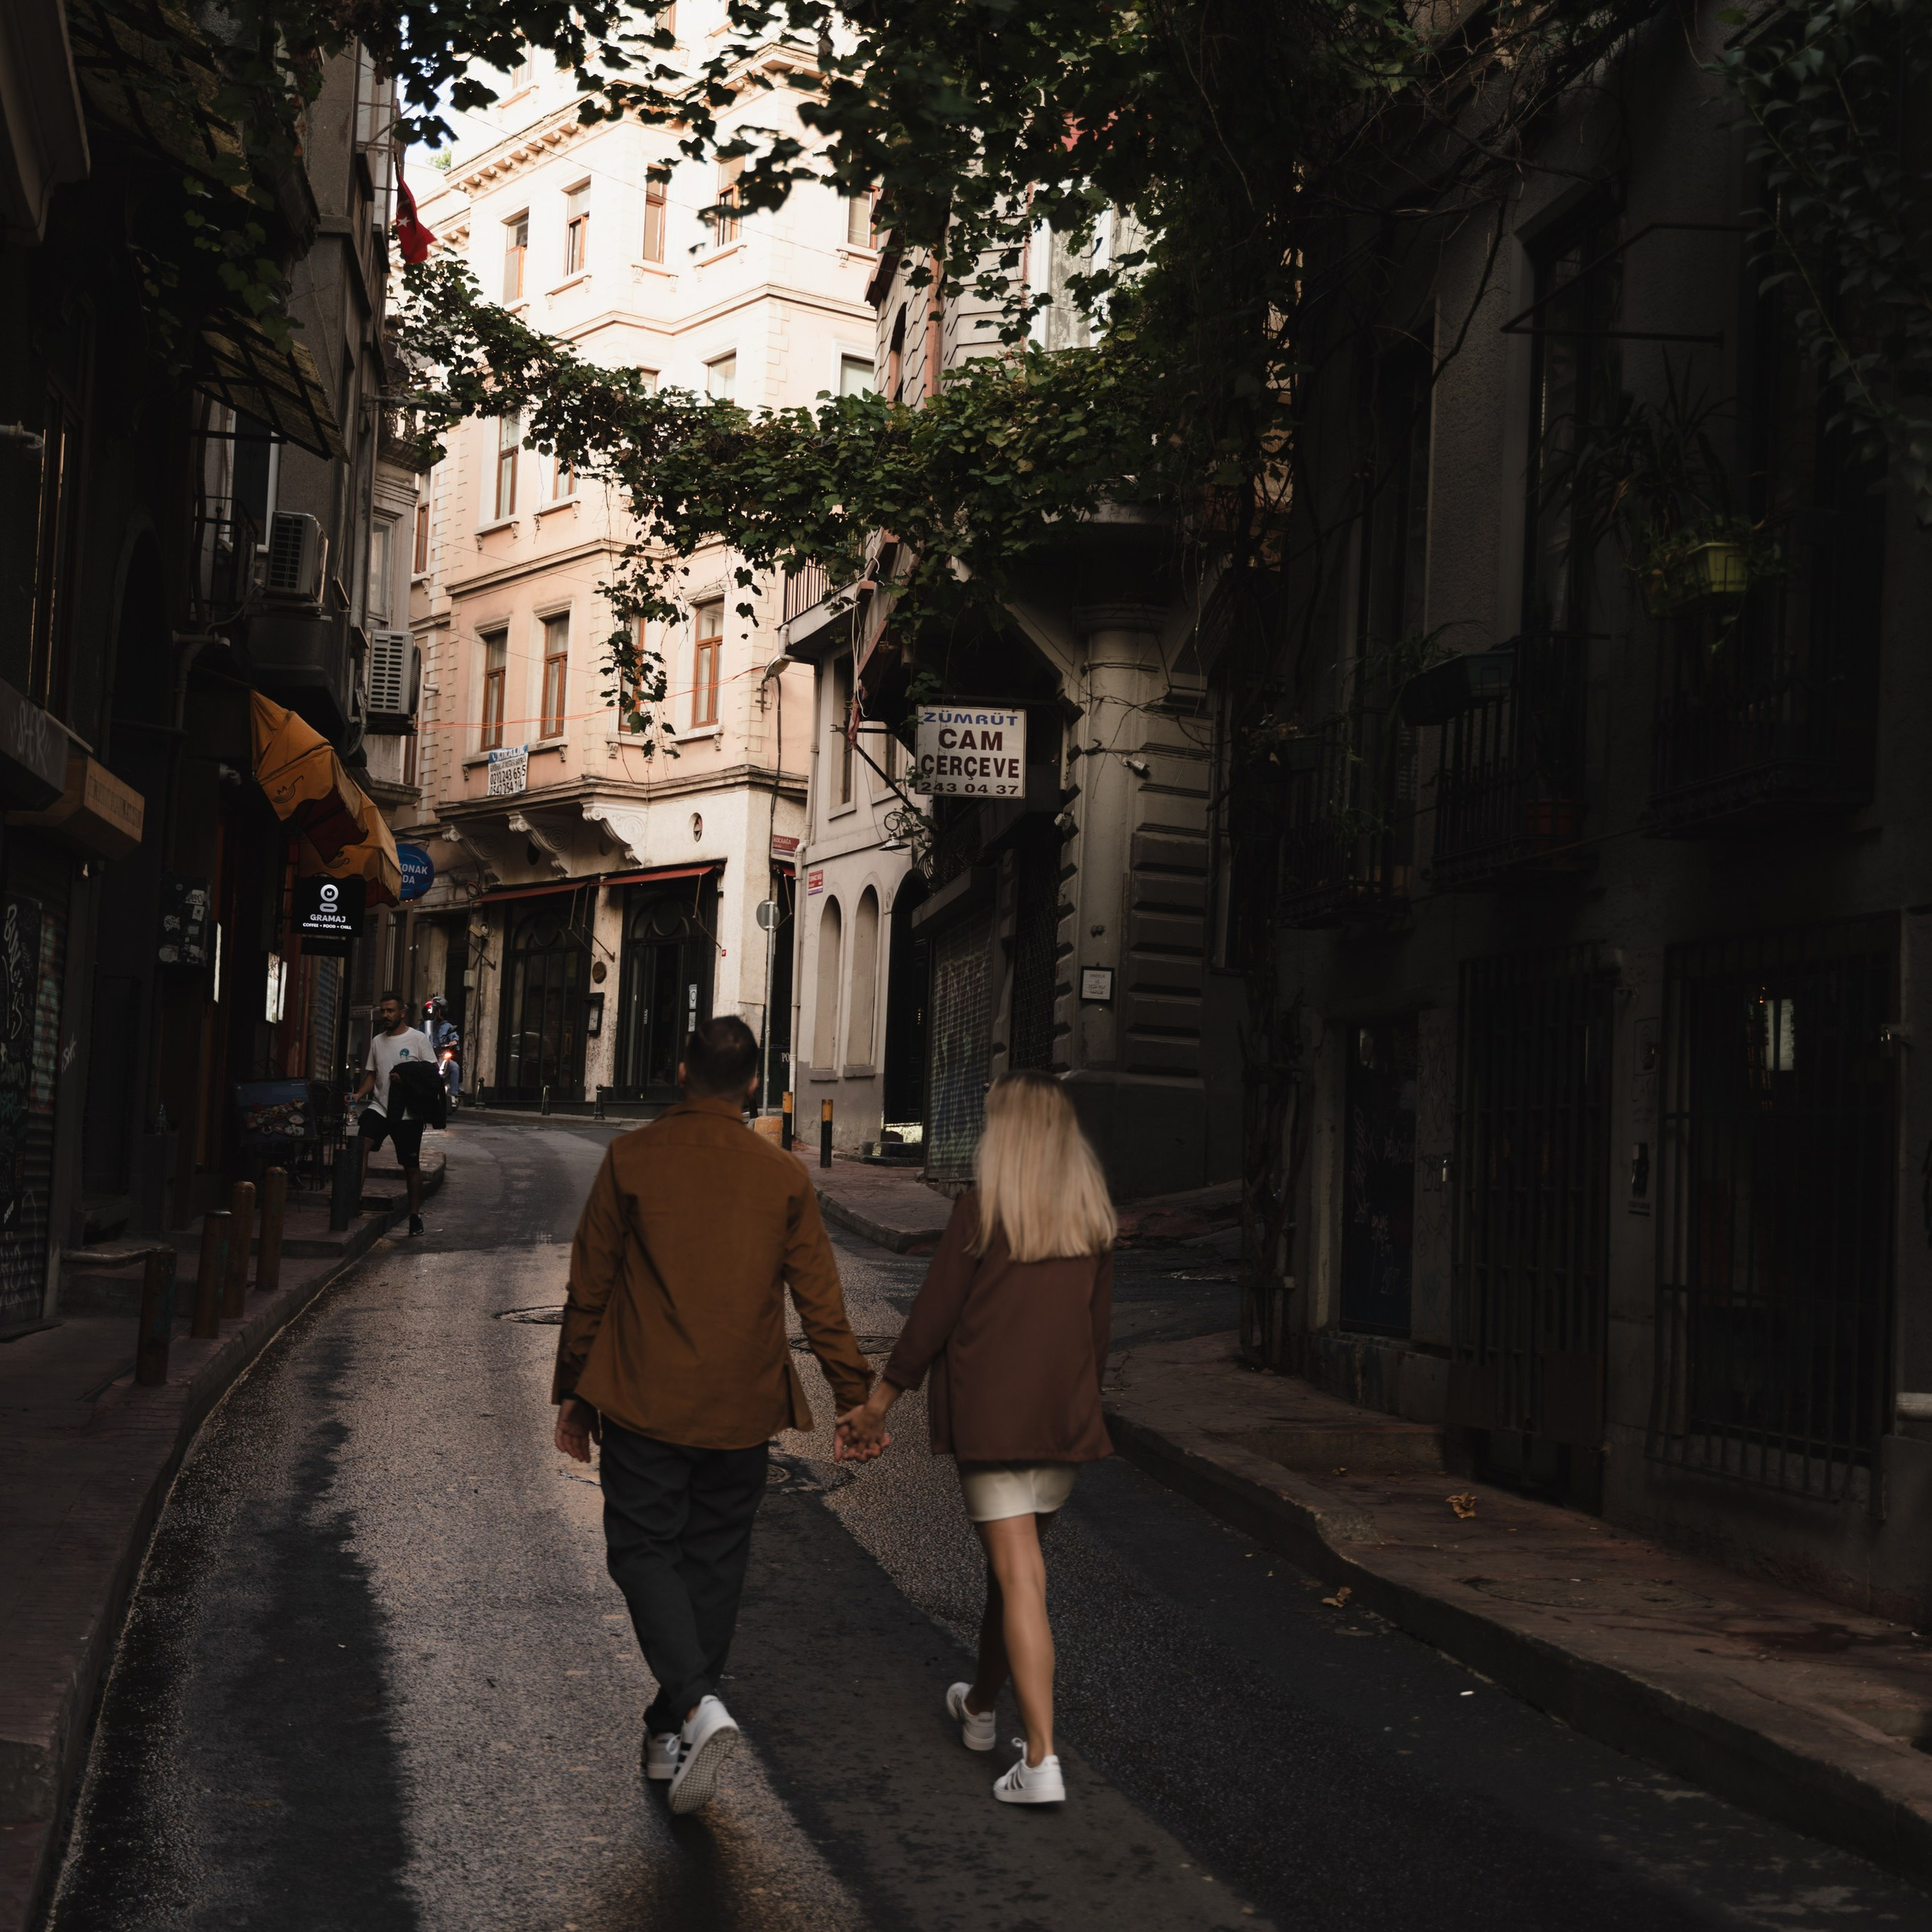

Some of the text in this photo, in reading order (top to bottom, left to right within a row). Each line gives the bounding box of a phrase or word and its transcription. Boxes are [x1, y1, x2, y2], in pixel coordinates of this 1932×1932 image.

[923, 710, 1018, 726] ZÜMRÜT
[939, 728, 1003, 751] CAM
[921, 755, 1019, 780] ÇERÇEVE
[921, 782, 1019, 795] 243 04 37
[399, 863, 429, 875] ONAK
[309, 913, 346, 923] GRAMAJ
